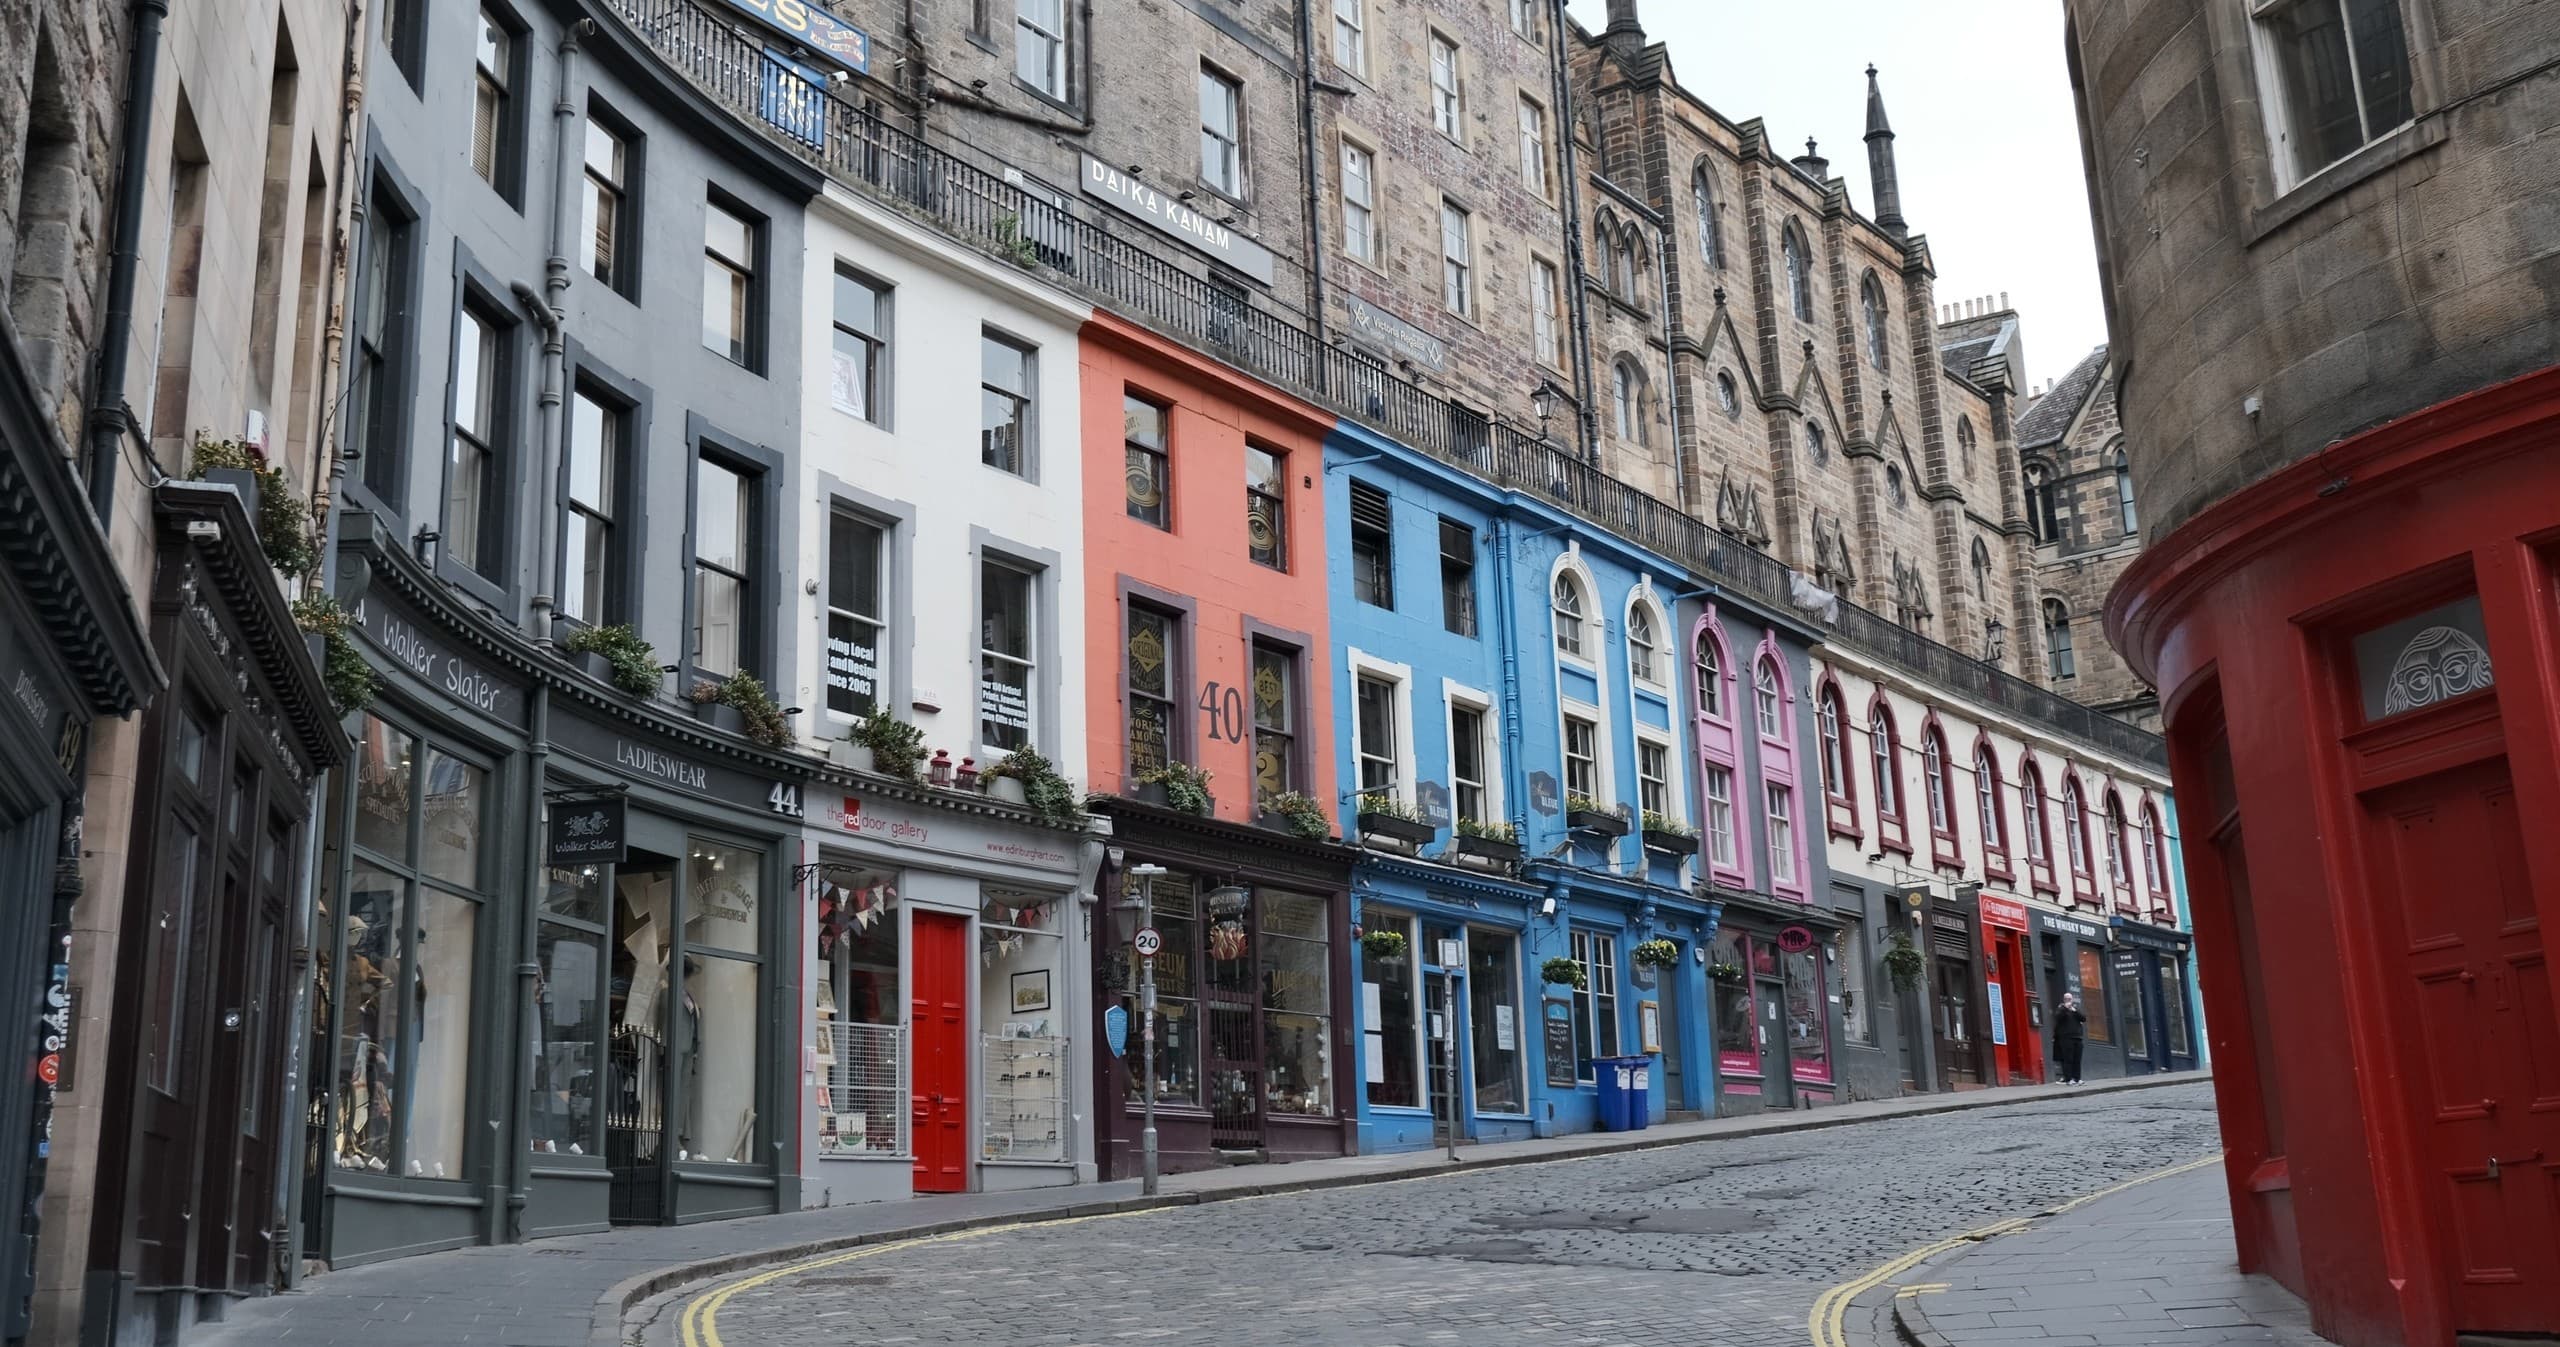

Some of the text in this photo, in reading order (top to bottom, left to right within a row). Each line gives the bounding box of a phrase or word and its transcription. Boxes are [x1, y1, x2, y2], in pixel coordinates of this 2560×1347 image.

[1092, 159, 1229, 250] DAIKA KANAM
[851, 641, 875, 662] Local
[383, 613, 437, 677] Walker
[446, 657, 500, 712] Slater
[830, 656, 880, 680] and Design
[848, 676, 871, 696] 2003
[1198, 681, 1244, 745] 40
[616, 739, 707, 790] LADIESWEAR
[768, 782, 804, 818] 44.
[1541, 795, 1559, 809] BLEUE
[827, 803, 929, 842] the red door gallery
[1429, 805, 1449, 820] BLEUE
[555, 840, 617, 853] Walker Slater
[986, 843, 1065, 863] www.edinburghart.com
[2043, 916, 2096, 937] THE WHISKY SHOP
[1137, 935, 1158, 949] 20
[2115, 961, 2139, 969] WHISKY
